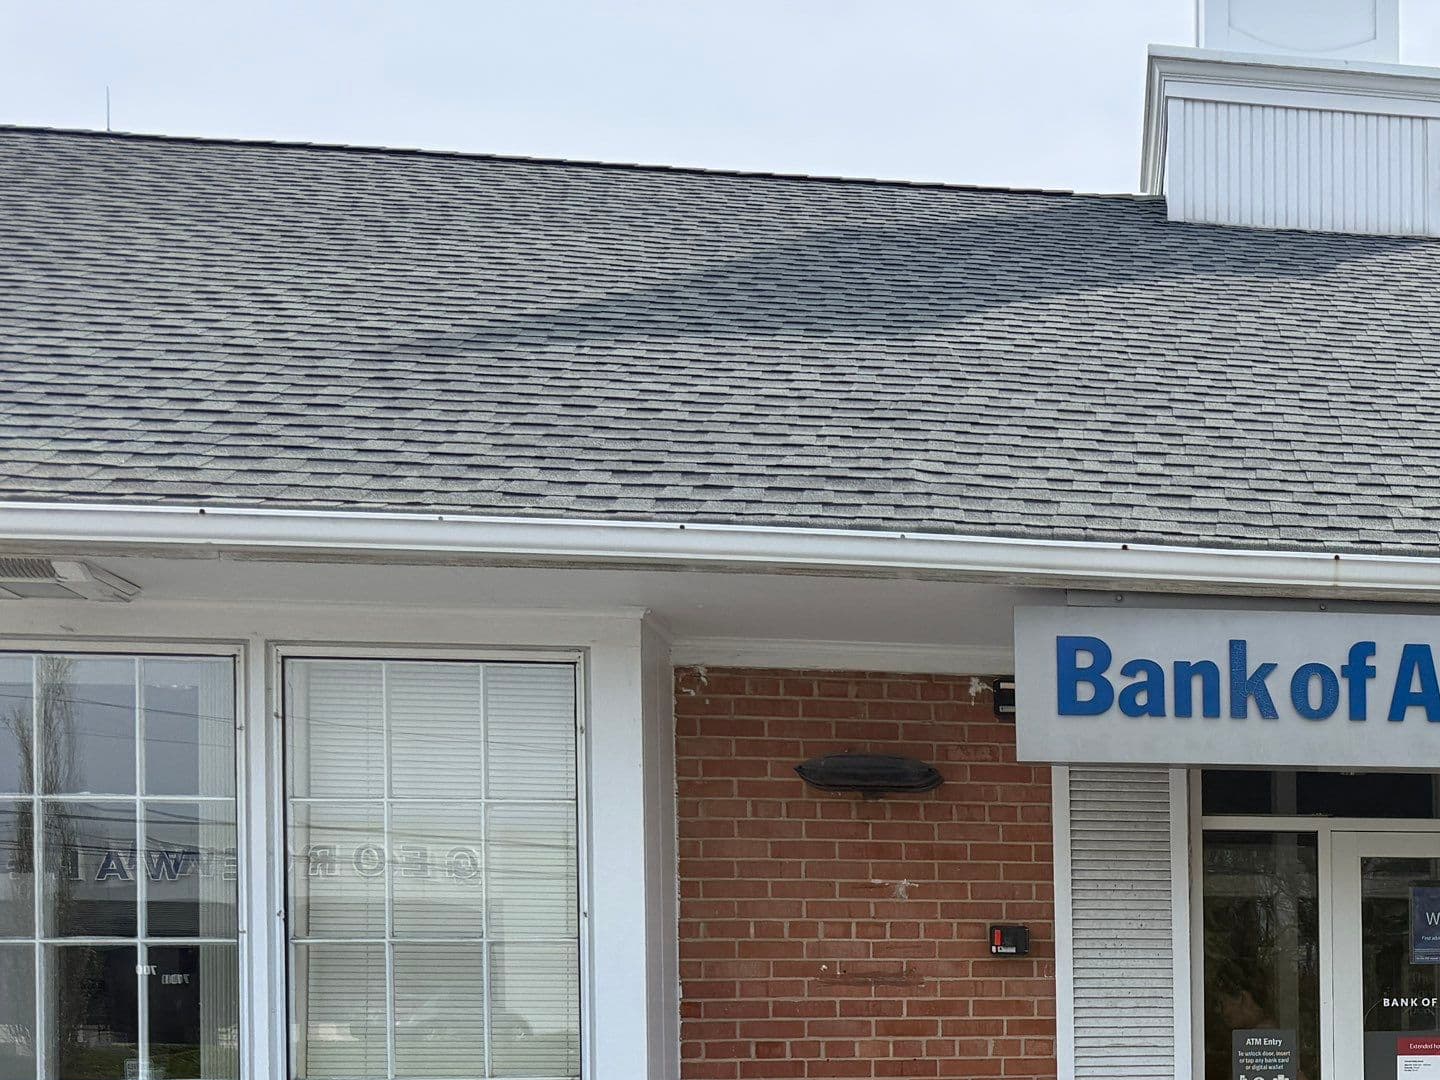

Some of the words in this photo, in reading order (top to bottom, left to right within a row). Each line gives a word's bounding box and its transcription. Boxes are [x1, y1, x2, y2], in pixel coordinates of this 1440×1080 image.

[1056, 635, 1279, 719] Bank
[1290, 641, 1376, 720] of
[1383, 998, 1418, 1007] BANK
[1421, 997, 1437, 1007] OF
[1245, 1038, 1262, 1046] ATM
[1263, 1038, 1282, 1047] Entry
